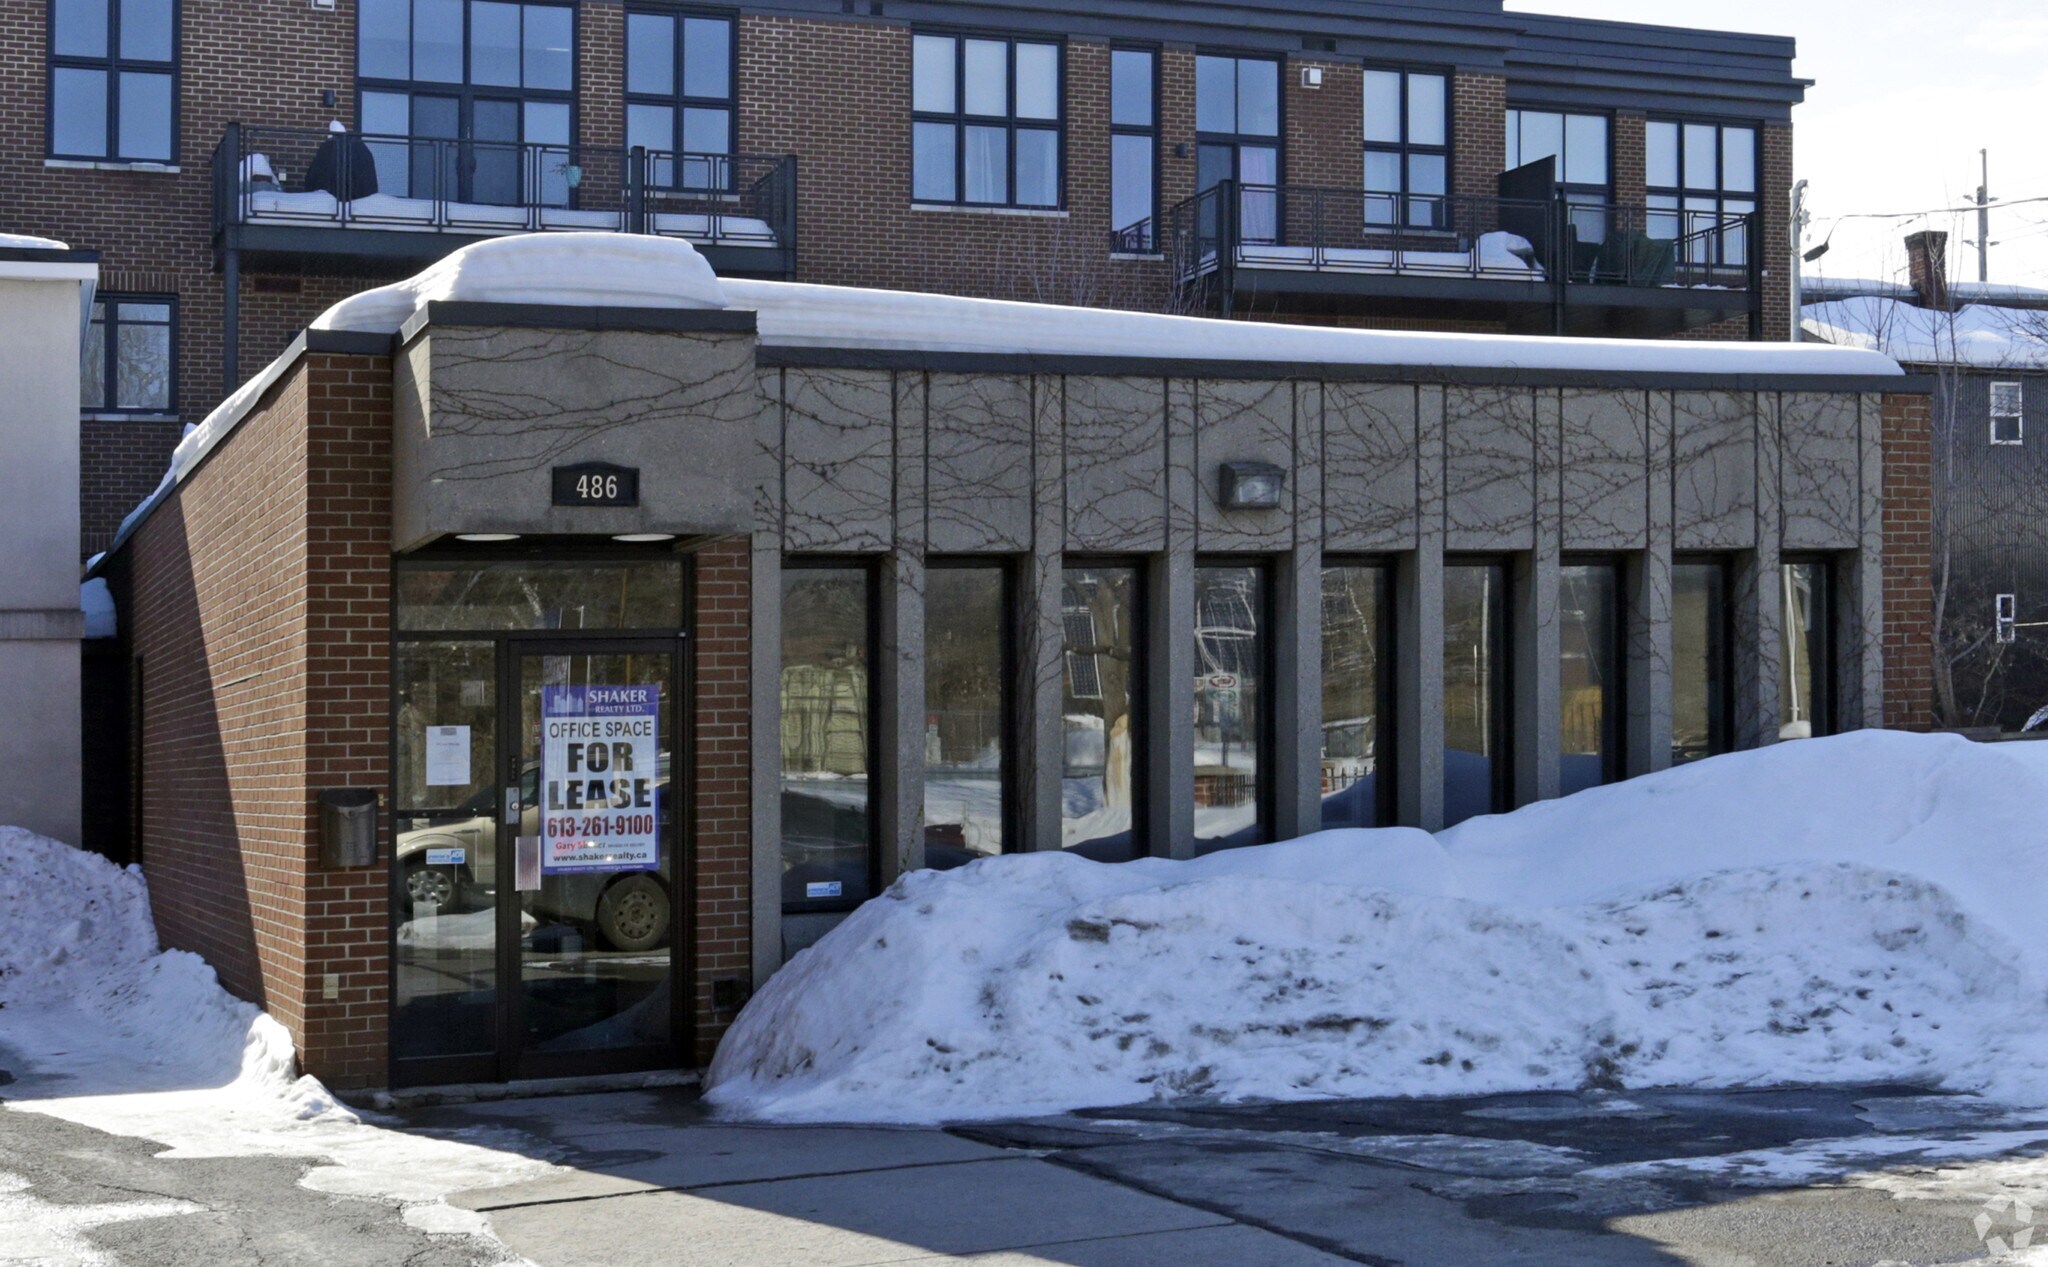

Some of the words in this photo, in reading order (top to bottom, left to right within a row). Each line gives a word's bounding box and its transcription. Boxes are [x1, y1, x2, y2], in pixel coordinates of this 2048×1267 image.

[576, 474, 618, 499] 486
[589, 689, 648, 704] SHAKER
[595, 705, 623, 713] REALTY
[626, 704, 645, 713] LTD.
[549, 721, 601, 739] OFFICE
[605, 720, 652, 737] SPACE
[567, 741, 634, 774] FOR
[548, 777, 652, 811] LEASE
[547, 814, 653, 838] 613-261-9100
[555, 841, 576, 851] Gary
